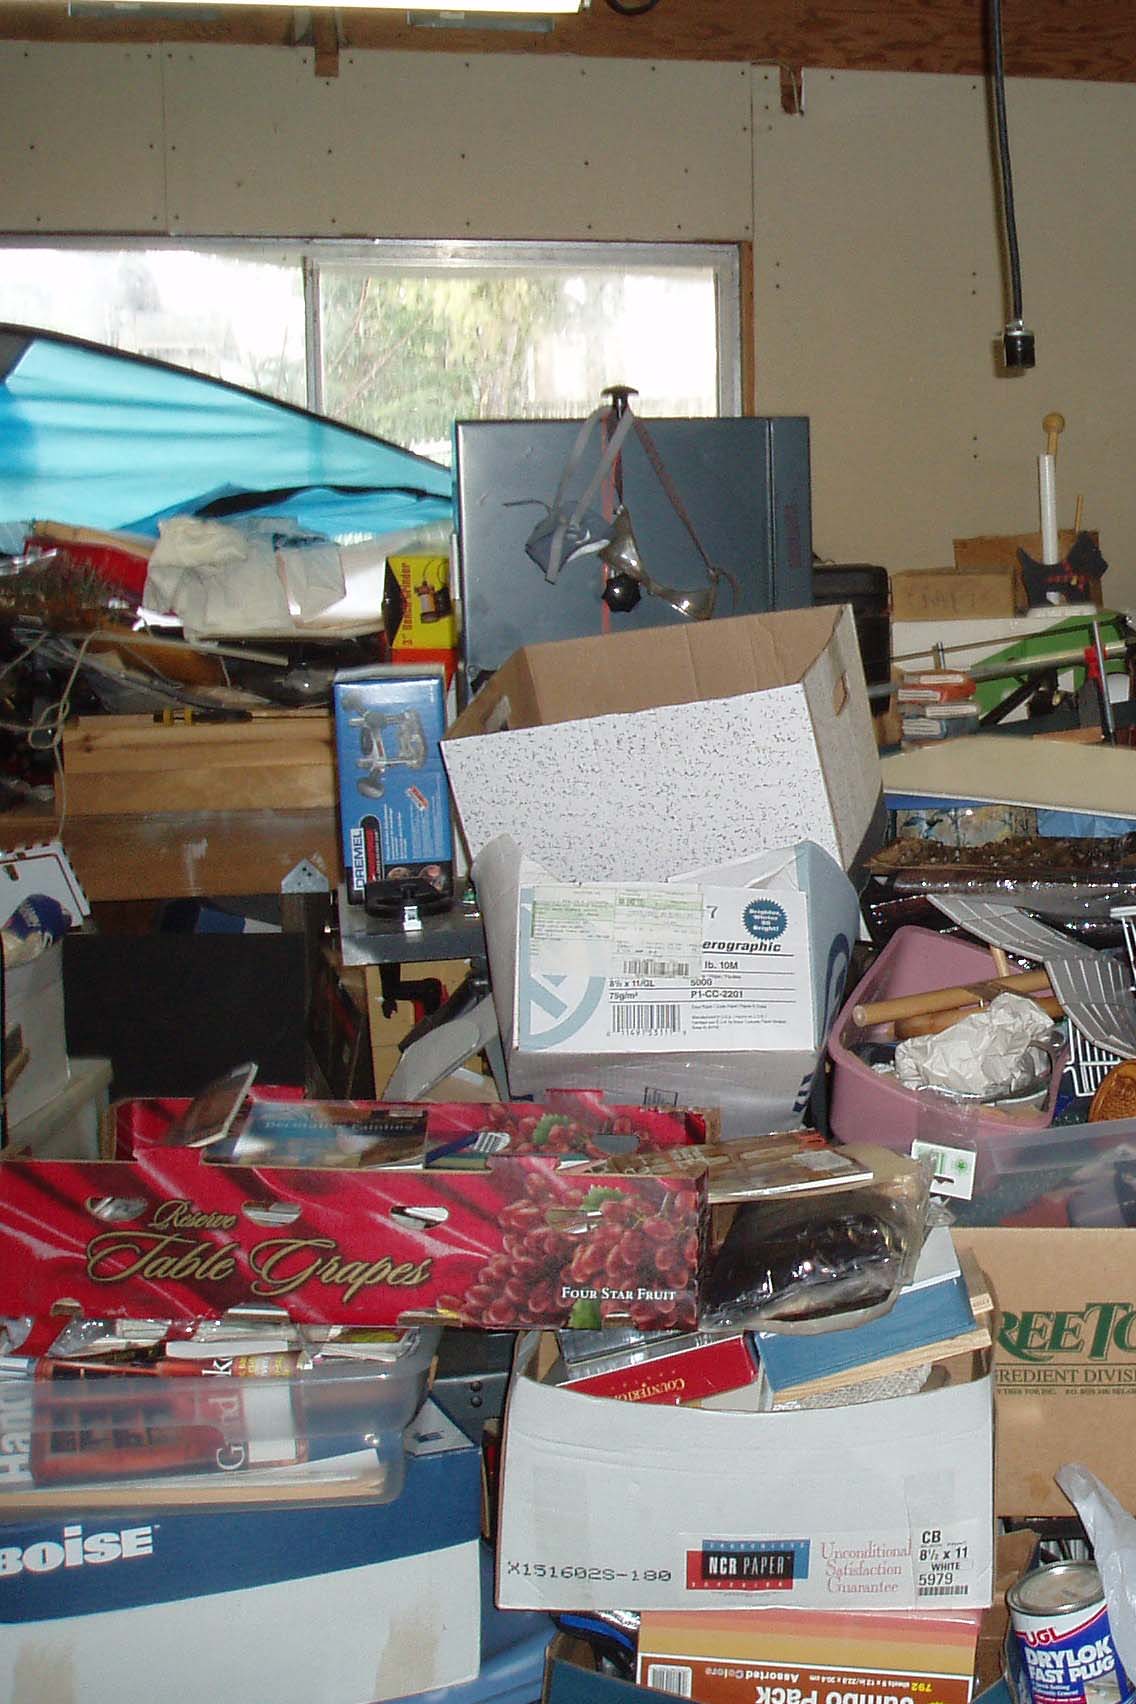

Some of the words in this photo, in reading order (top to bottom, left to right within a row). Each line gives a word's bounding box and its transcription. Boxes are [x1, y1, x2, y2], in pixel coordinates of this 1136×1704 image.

[353, 829, 365, 890] DREMEL
[702, 940, 782, 954] erographic
[149, 1199, 237, 1230] Reserve
[86, 1231, 242, 1282] Table
[249, 1238, 433, 1304] Grapes
[561, 1286, 598, 1299] FOUR
[601, 1287, 633, 1300] STAR
[637, 1288, 677, 1300] FRUIT
[921, 1530, 942, 1544] CB
[820, 1536, 912, 1561] Unconditional
[956, 1546, 968, 1558] 11
[708, 1556, 738, 1576] NCR
[742, 1555, 785, 1576] PAPER
[825, 1558, 902, 1578] Satisfaction
[930, 1561, 961, 1572] WHITE
[827, 1576, 899, 1594] Guarantee
[918, 1572, 953, 1586] 5979
[1025, 1626, 1061, 1647] UGL
[1023, 1634, 1113, 1669] DRYLOK
[745, 1669, 800, 1683] Assorted
[1028, 1666, 1066, 1684] FAST
[1068, 1654, 1116, 1683] PLUG
[911, 1682, 933, 1693] 792
